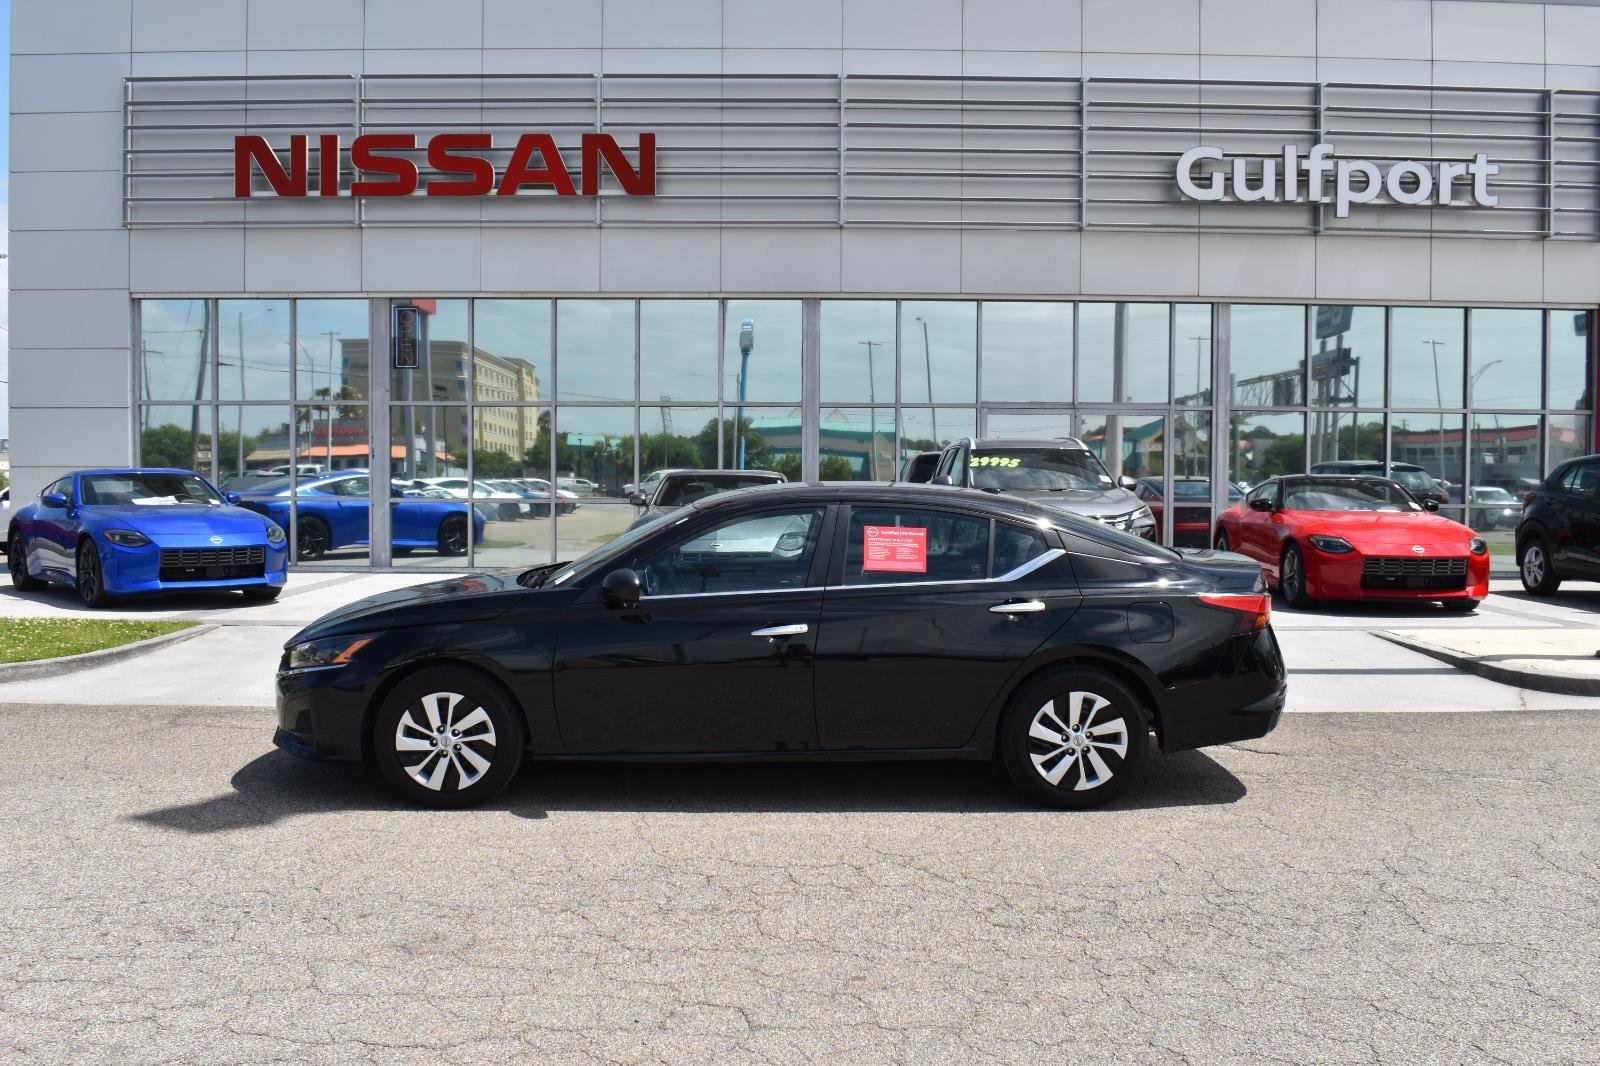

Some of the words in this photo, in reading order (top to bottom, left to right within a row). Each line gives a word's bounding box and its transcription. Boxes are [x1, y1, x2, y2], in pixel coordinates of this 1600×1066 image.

[235, 133, 656, 198] NISSAN
[1176, 142, 1499, 218] Gulfport
[400, 310, 414, 365] OPEN
[970, 456, 1021, 468] 29995
